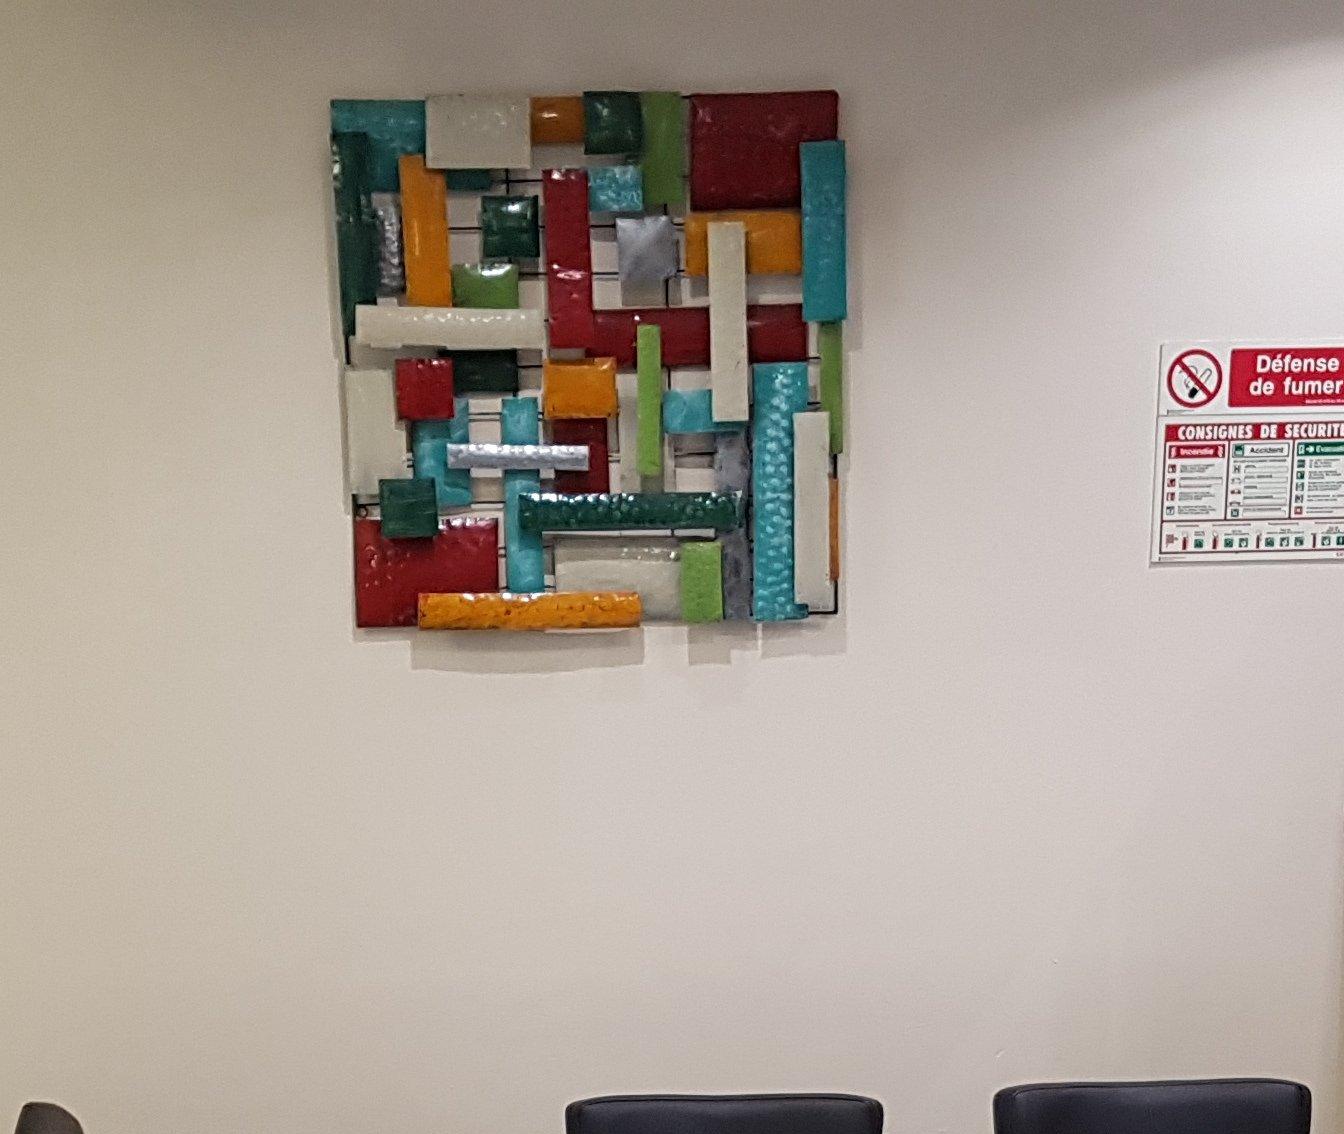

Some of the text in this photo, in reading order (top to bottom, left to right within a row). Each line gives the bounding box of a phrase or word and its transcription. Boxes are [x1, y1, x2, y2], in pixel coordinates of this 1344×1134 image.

[1256, 353, 1340, 373] Défense
[1249, 377, 1344, 395] de fumer
[1177, 424, 1253, 440] CONSIGNES
[1259, 424, 1278, 439] DE
[1249, 444, 1284, 454] Accident
